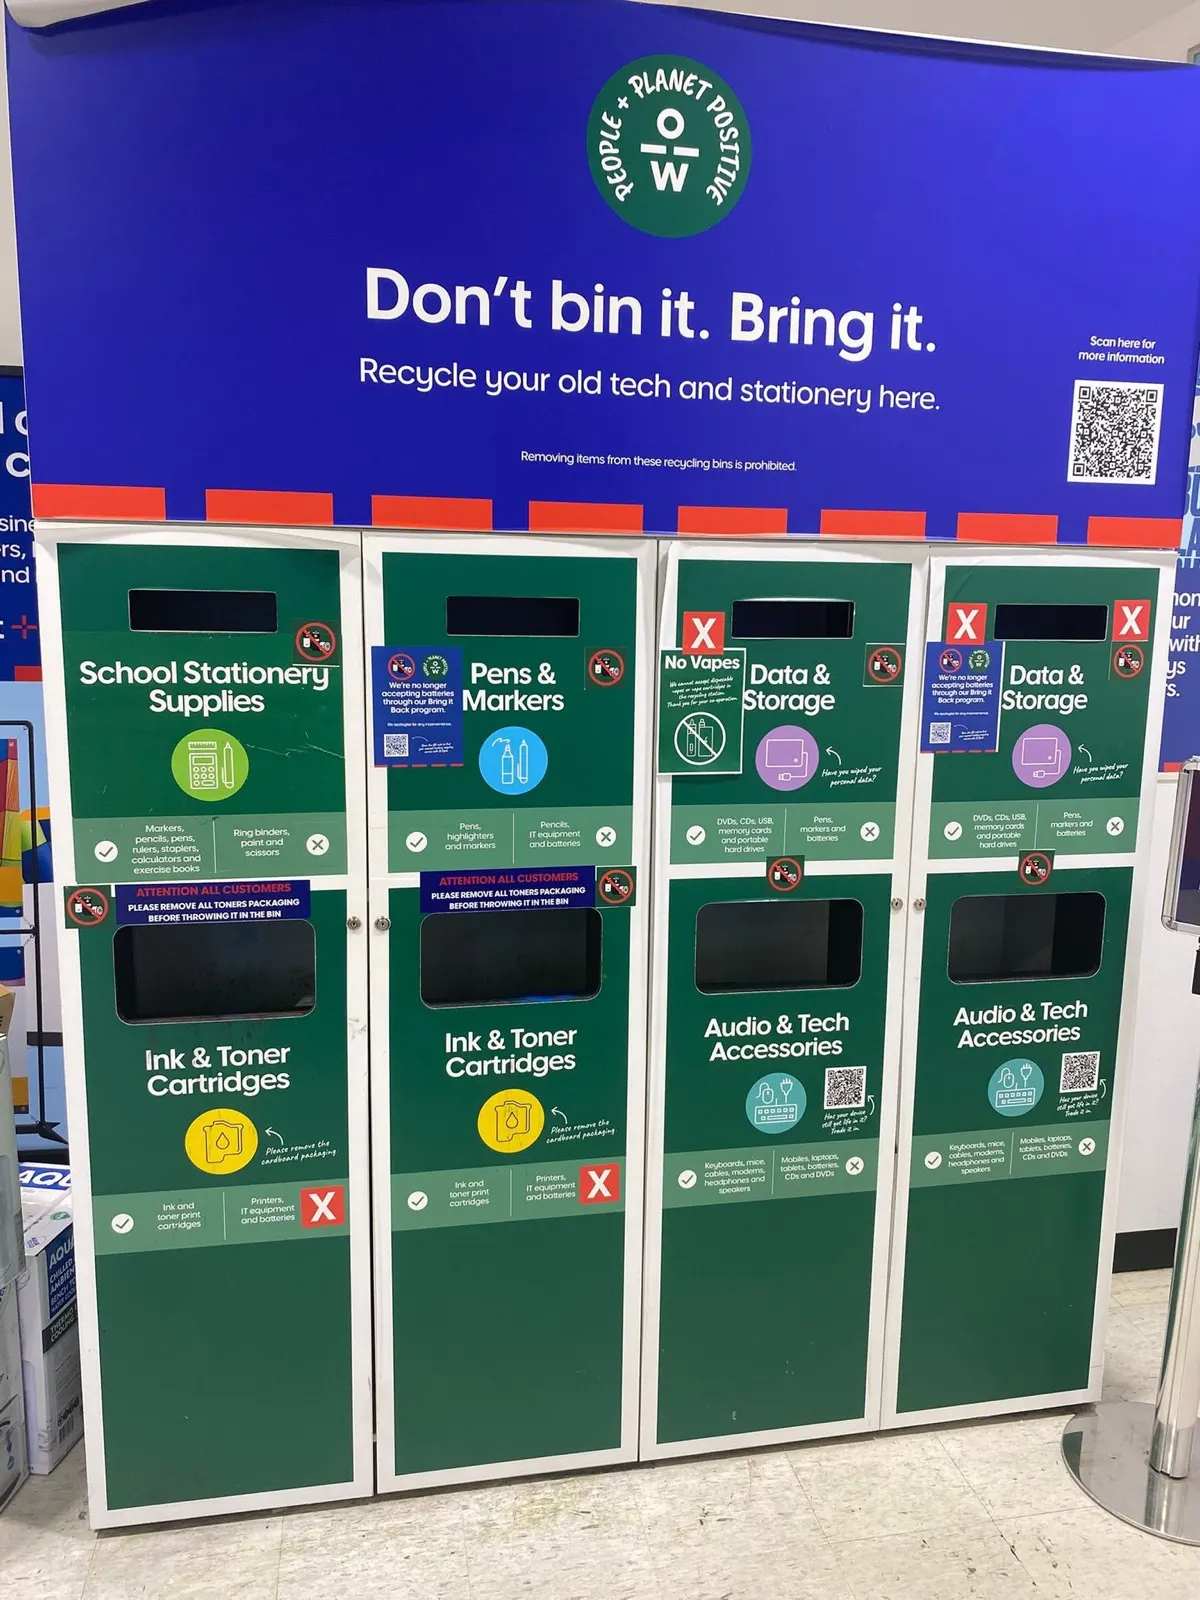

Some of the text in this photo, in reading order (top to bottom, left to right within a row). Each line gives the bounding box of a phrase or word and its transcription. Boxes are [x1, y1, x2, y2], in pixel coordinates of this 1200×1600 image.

[599, 111, 634, 202] PEOPLE
[628, 68, 713, 100] PLANET
[706, 95, 740, 206] POSITIVE
[650, 160, 689, 192] W
[367, 268, 935, 361] Don't bin it. Bring it.
[1090, 335, 1156, 349] Scan here for
[1079, 350, 1164, 364] more information
[360, 358, 940, 413] Recycle your old tech and stationery here.
[521, 450, 797, 473] Removing items from these recycling bins is prohibited.
[665, 655, 740, 672] No Vapes
[80, 661, 329, 690] School Stationery
[472, 663, 556, 684] Pens &
[751, 664, 830, 684] Data &
[1010, 665, 1084, 685] Data &
[382, 689, 420, 698] accepting
[150, 689, 265, 717] Supplies
[383, 697, 413, 706] through
[428, 697, 447, 706] Bring
[463, 690, 564, 711] Markers
[743, 689, 836, 716] Storage
[1002, 689, 1088, 714] Storage
[391, 705, 446, 715] Back program.
[234, 827, 253, 838] Ring
[447, 831, 494, 841] highlighters
[530, 829, 580, 839] IT equipment
[241, 837, 283, 848] paint and
[445, 840, 496, 850] and markers
[529, 838, 580, 847] and batteries
[132, 853, 201, 863] calculators and
[246, 847, 280, 856] scissors
[134, 864, 200, 874] exercise books
[439, 873, 579, 886] ATTENTION ALL CUSTOMERS
[137, 884, 291, 897] ATTENTION ALL CUSTOMERS
[432, 891, 459, 899] PLEASE
[461, 890, 493, 898] REMOVE
[509, 888, 539, 896] TONERS
[540, 886, 586, 894] PACKAGING
[128, 903, 159, 911] PLEASE
[160, 902, 196, 910] REMOVE
[214, 900, 247, 908] TONERS
[249, 898, 299, 907] PACKAGING
[449, 901, 478, 909] BEFORE
[479, 899, 522, 908] THROWING
[149, 913, 180, 921] BEFORE
[182, 912, 229, 920] THROWING
[250, 910, 265, 918] THE
[953, 1000, 1087, 1026] Audio & Tech
[704, 1013, 849, 1037] Audio & Tech
[446, 1028, 577, 1053] Ink & Toner
[958, 1024, 1080, 1048] Accessories
[709, 1037, 842, 1061] Accessories
[146, 1046, 290, 1070] Ink & Toner
[446, 1053, 576, 1077] Cartridges
[148, 1071, 290, 1096] Cartridges
[800, 1171, 815, 1179] and
[163, 1201, 194, 1210] Ink and
[241, 1203, 294, 1216] IT equipment
[157, 1210, 200, 1220] toner print
[241, 1212, 295, 1224] and batteries
[158, 1219, 201, 1231] cartridges
